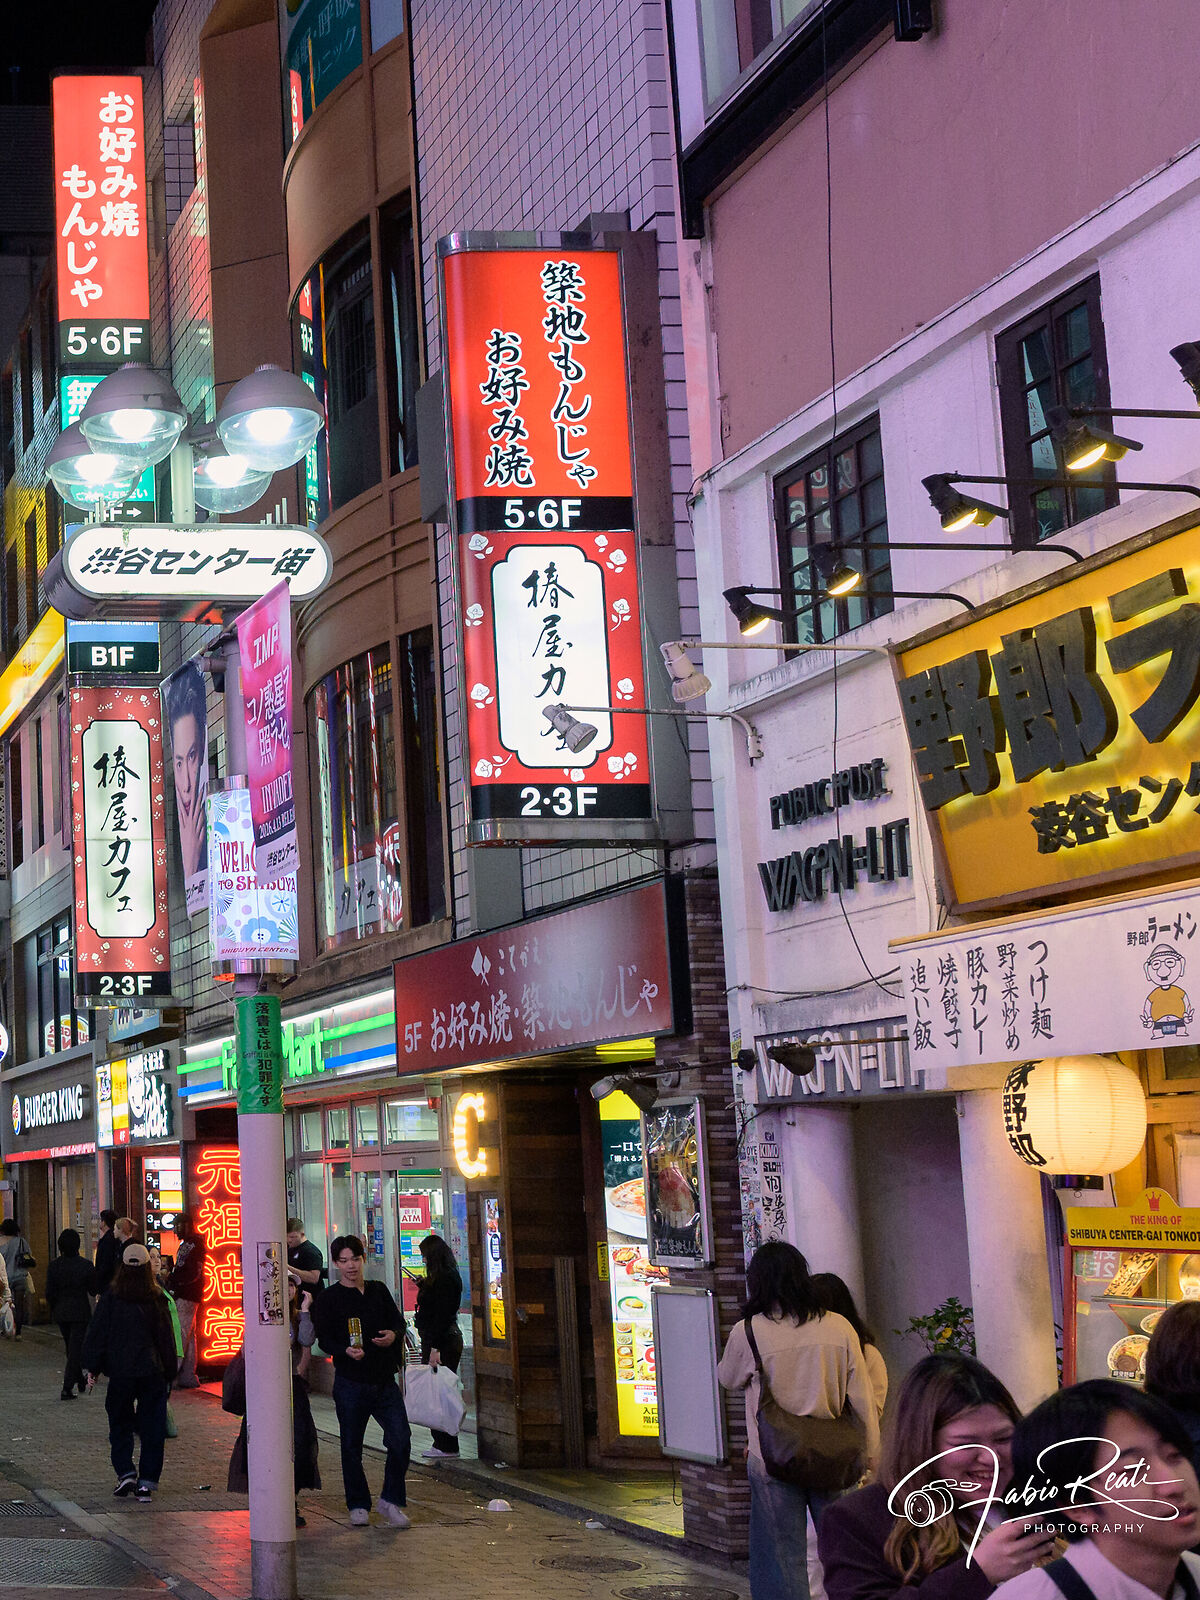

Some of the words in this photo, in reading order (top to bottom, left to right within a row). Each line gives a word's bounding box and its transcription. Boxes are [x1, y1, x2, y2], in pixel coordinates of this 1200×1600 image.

[98, 90, 140, 237] お好み焼
[61, 164, 103, 308] もんじゃ
[482, 330, 535, 487] お好み焼
[542, 262, 597, 488] 築地もんじゃ
[80, 547, 316, 577] 渋谷センター街
[91, 646, 135, 667] B1F
[260, 769, 294, 815] INVADER
[93, 744, 141, 914] 椿屋カフェ
[218, 877, 235, 891] TO
[220, 945, 256, 955] SHIBUYA
[258, 945, 289, 953] CENTER
[1126, 911, 1199, 947] 野郎ラーメン
[910, 957, 937, 1052] 追い飯
[937, 952, 964, 1050] 焼餃子
[966, 949, 990, 1055] 豚カレー
[996, 942, 1021, 1053] 野菜炒め
[1027, 939, 1056, 1041] つけ麺
[255, 1002, 273, 1107] 落書きは犯罪です
[404, 1021, 422, 1053] 5F
[24, 1090, 58, 1129] BURGER
[58, 1083, 83, 1122] KING
[760, 1144, 779, 1158] KIMO
[401, 1214, 421, 1222] ATM
[1070, 1228, 1108, 1240] SHIBUYA
[1130, 1215, 1145, 1225] THE
[1147, 1215, 1169, 1225] KING
[1170, 1215, 1182, 1225] OF
[196, 1146, 245, 1362] 元祖油堂
